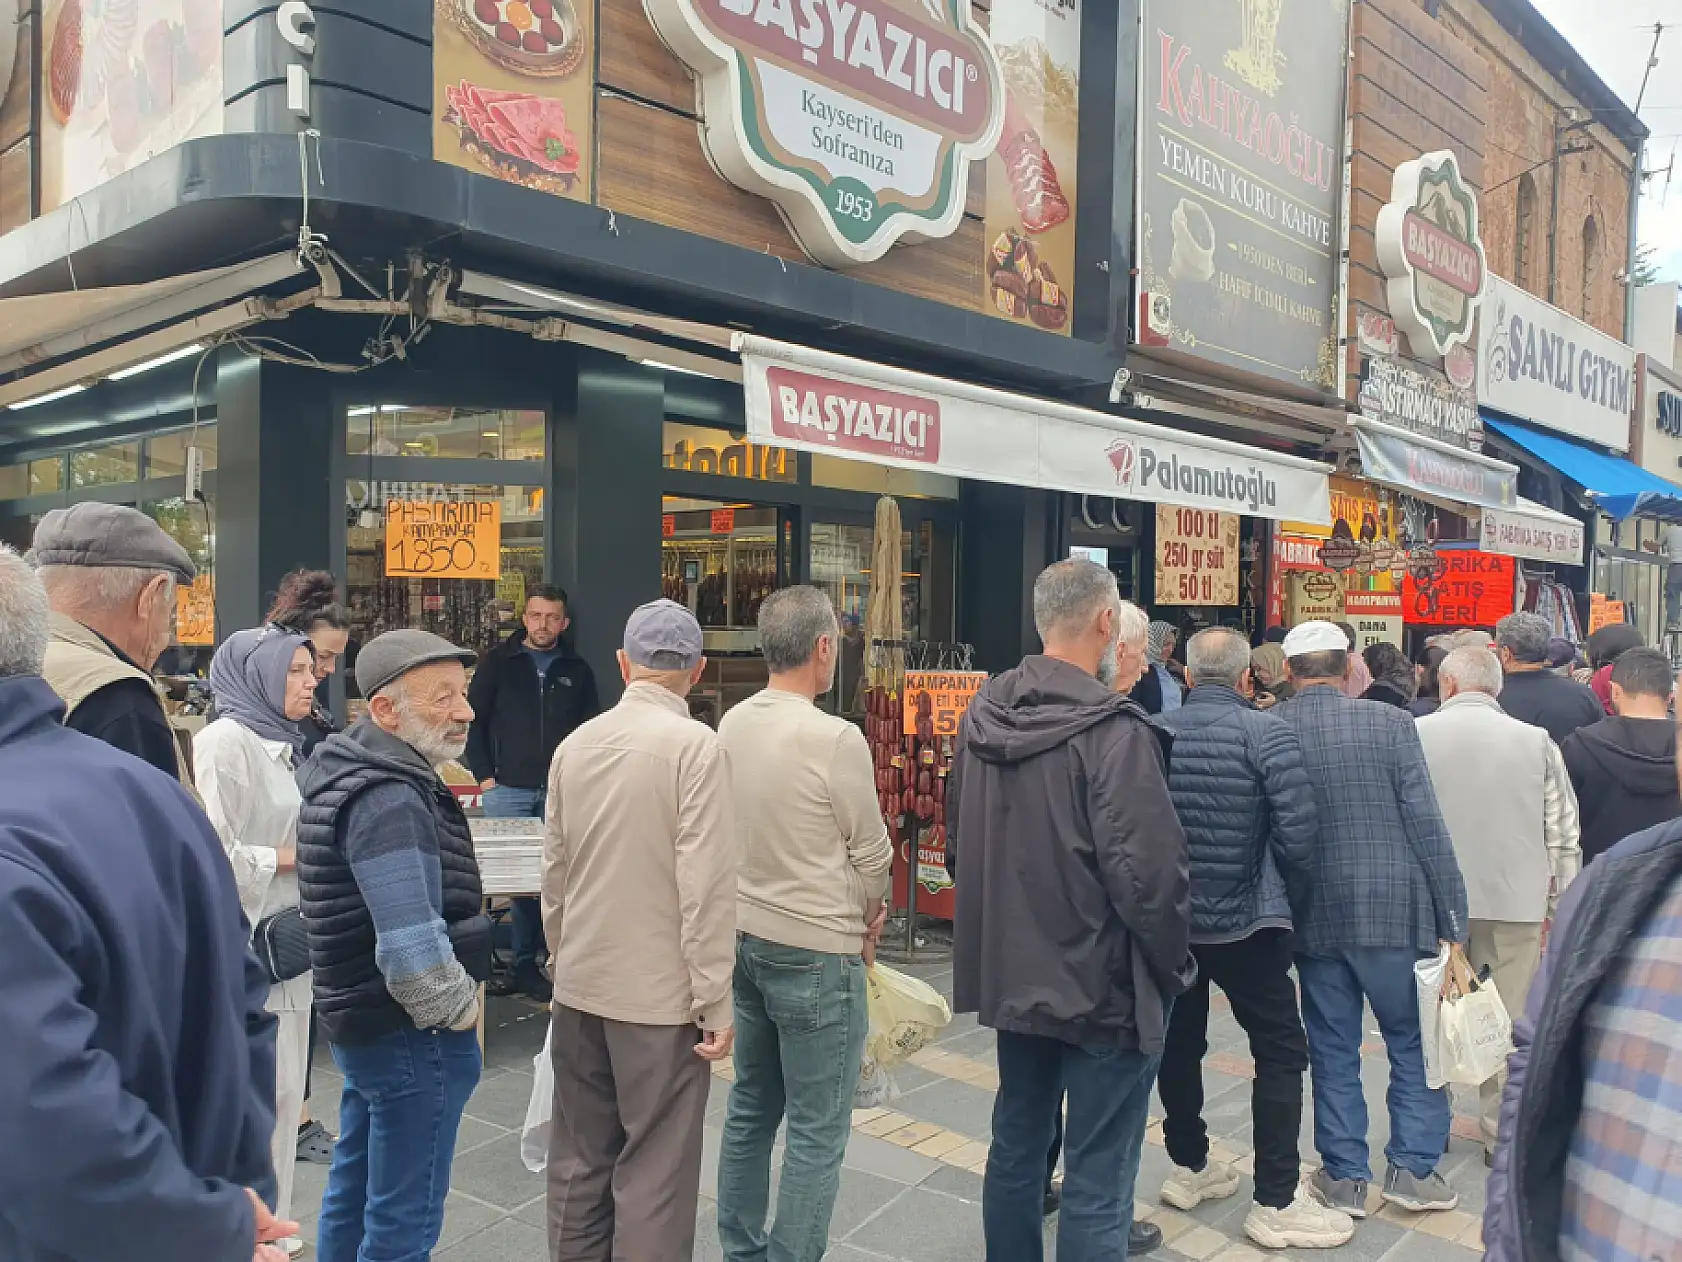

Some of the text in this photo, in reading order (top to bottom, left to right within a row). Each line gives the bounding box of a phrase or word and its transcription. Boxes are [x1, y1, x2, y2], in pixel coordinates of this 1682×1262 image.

[718, 0, 964, 114] AŞYAZICI
[801, 90, 903, 150] Kayseri'den
[1157, 28, 1334, 192] KAHYAOĞLU
[812, 125, 894, 176] Sofranıza
[835, 189, 873, 222] 1953
[1159, 135, 1330, 246] YEMEN KURU KAHVE
[1140, 447, 1276, 512] Palamutoğlu
[1176, 508, 1204, 537] 100
[388, 538, 476, 572] 1850
[1164, 541, 1187, 568] 250
[1192, 549, 1204, 572] gr
[1180, 574, 1212, 601] 50 tl
[937, 710, 955, 732] 5
